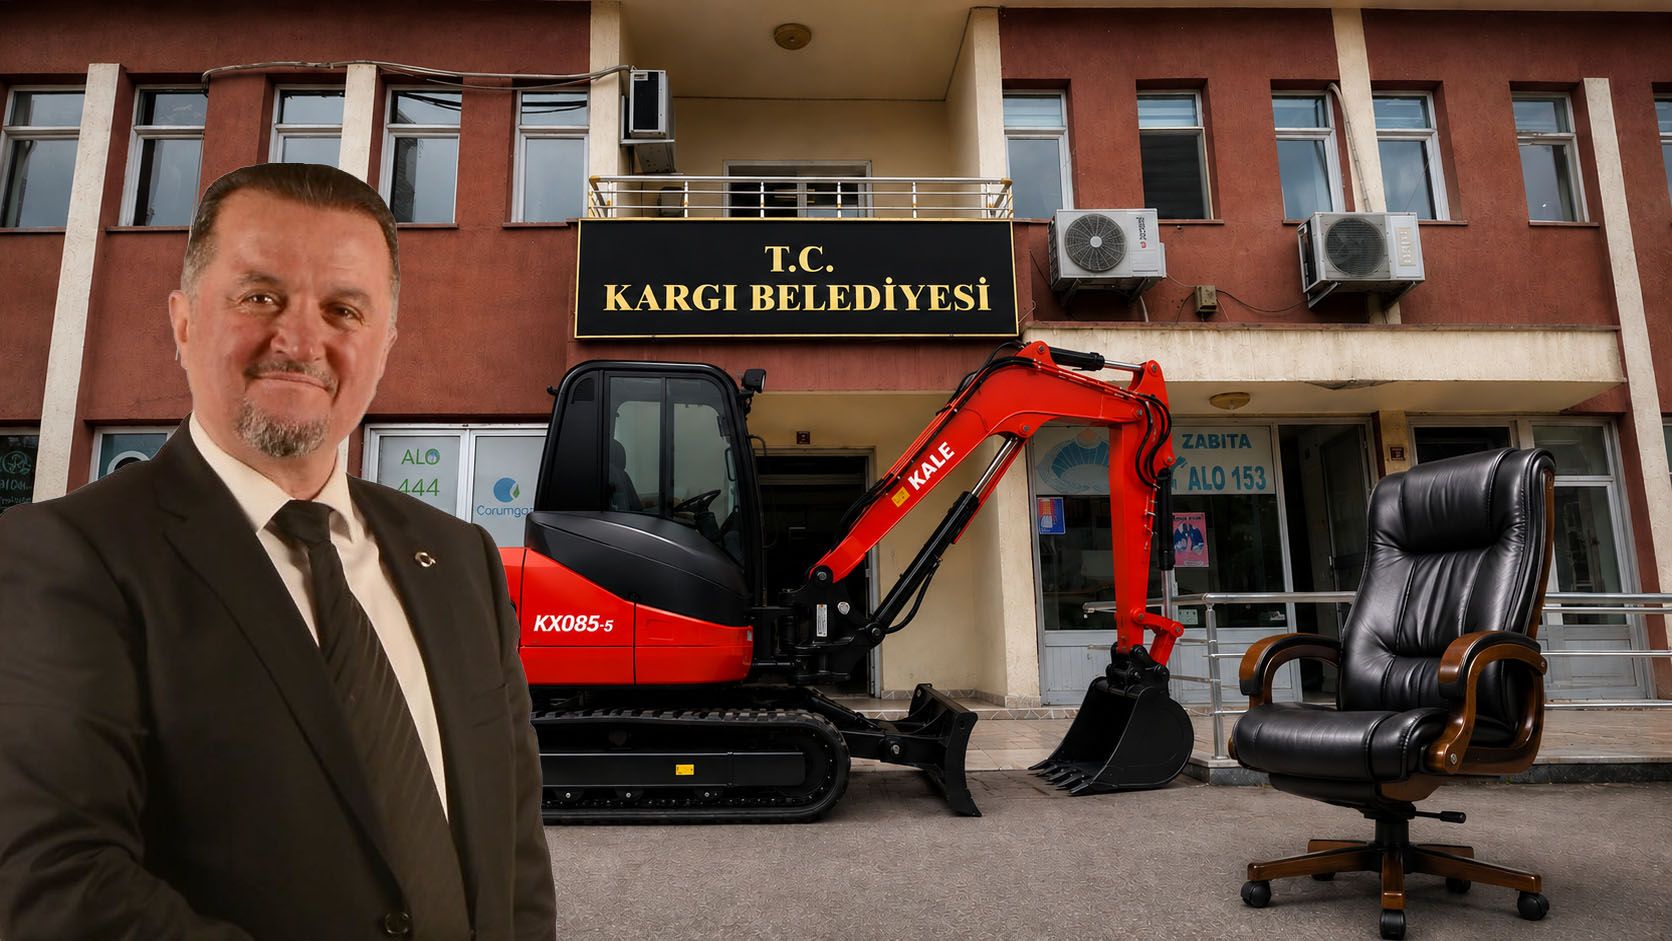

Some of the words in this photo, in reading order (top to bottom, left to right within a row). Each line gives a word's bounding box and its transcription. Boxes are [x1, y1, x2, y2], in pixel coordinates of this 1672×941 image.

[764, 245, 834, 273] T.C.
[603, 284, 738, 311] KARGI
[749, 276, 992, 311] BELEDİYESİ
[1181, 433, 1252, 449] ZABITA
[401, 448, 441, 465] ALO
[907, 441, 955, 491] KALE
[398, 478, 440, 497] 444
[1187, 465, 1226, 490] ALO
[1231, 465, 1267, 490] 153
[533, 614, 614, 632] KX085-5
